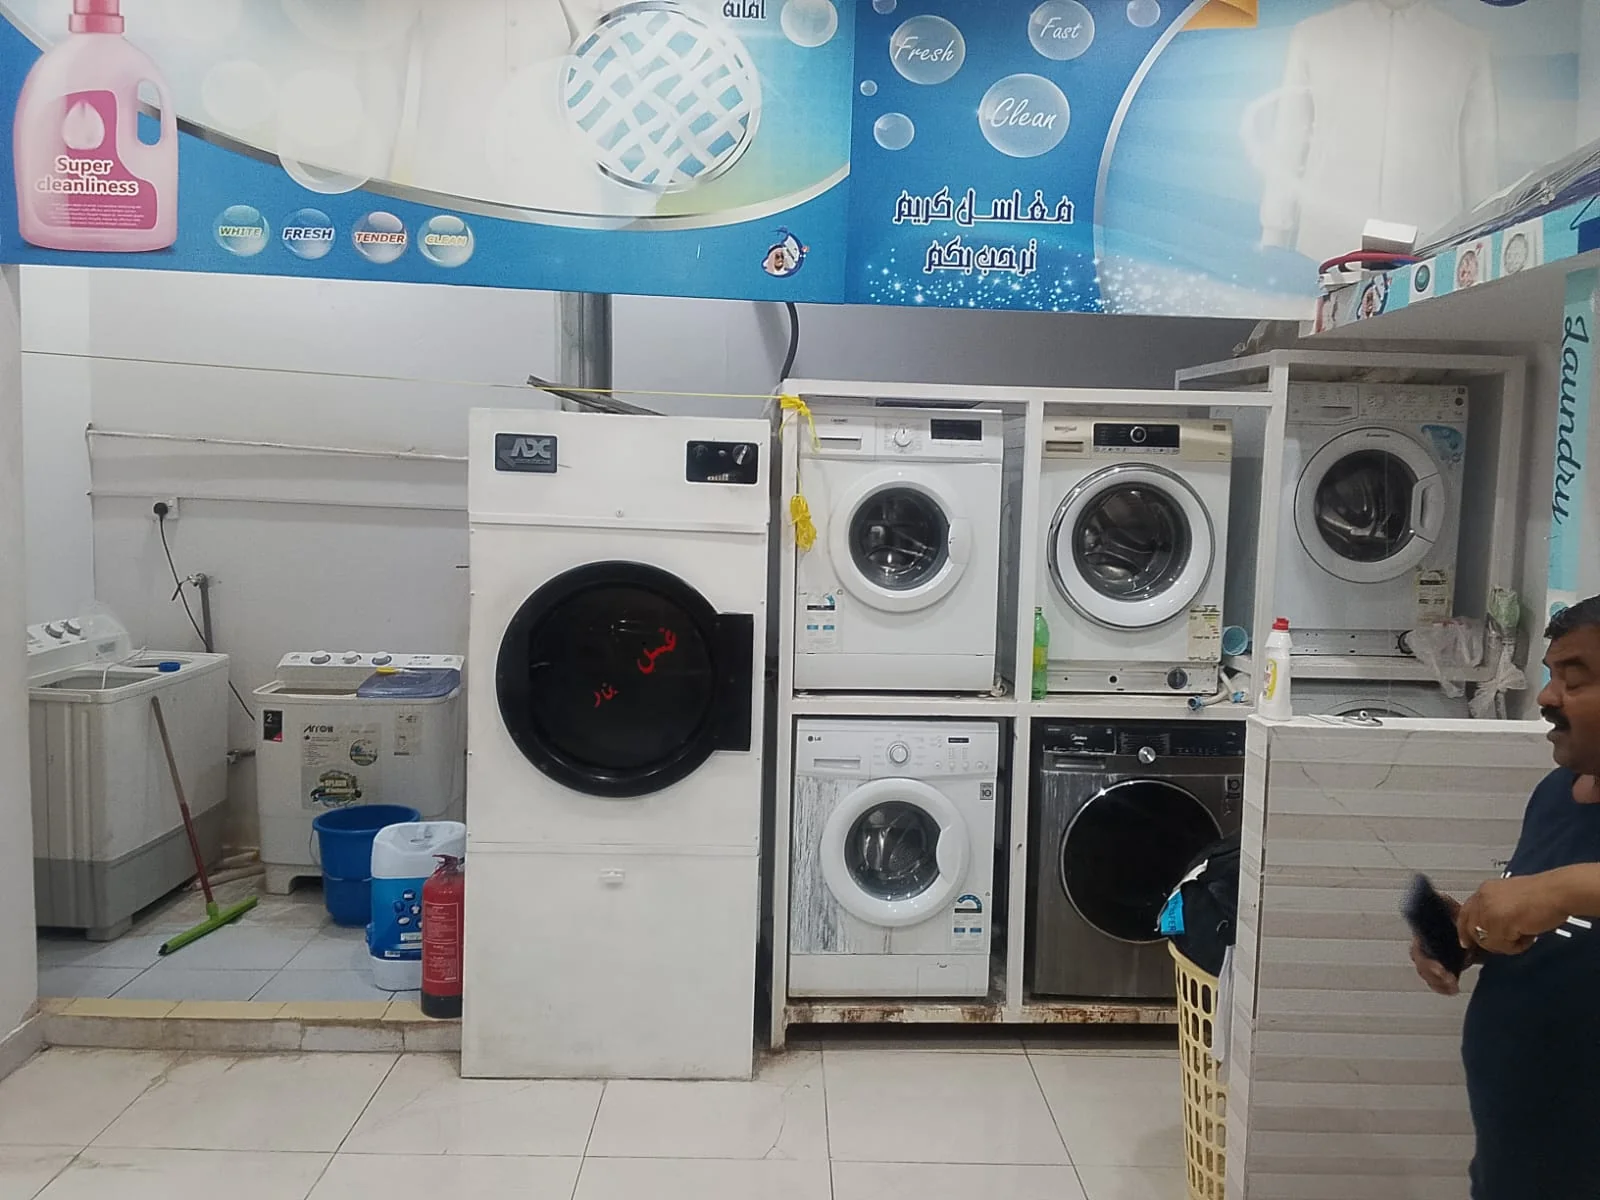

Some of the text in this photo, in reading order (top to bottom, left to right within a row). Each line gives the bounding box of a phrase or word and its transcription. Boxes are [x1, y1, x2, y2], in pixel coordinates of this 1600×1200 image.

[1040, 17, 1081, 40] Fast
[894, 36, 955, 65] Fresh
[991, 98, 1058, 131] Clean
[57, 155, 112, 175] Super
[37, 176, 139, 196] cleanliness
[893, 185, 1074, 227] مغاسل كريم
[219, 225, 261, 238] WHITE
[283, 228, 335, 241] FRESH
[354, 232, 405, 245] TENDER
[424, 235, 467, 247] CLEAN
[923, 234, 1037, 275] ترحب بكم
[1552, 317, 1590, 525] Laundry
[511, 438, 552, 459] ADC
